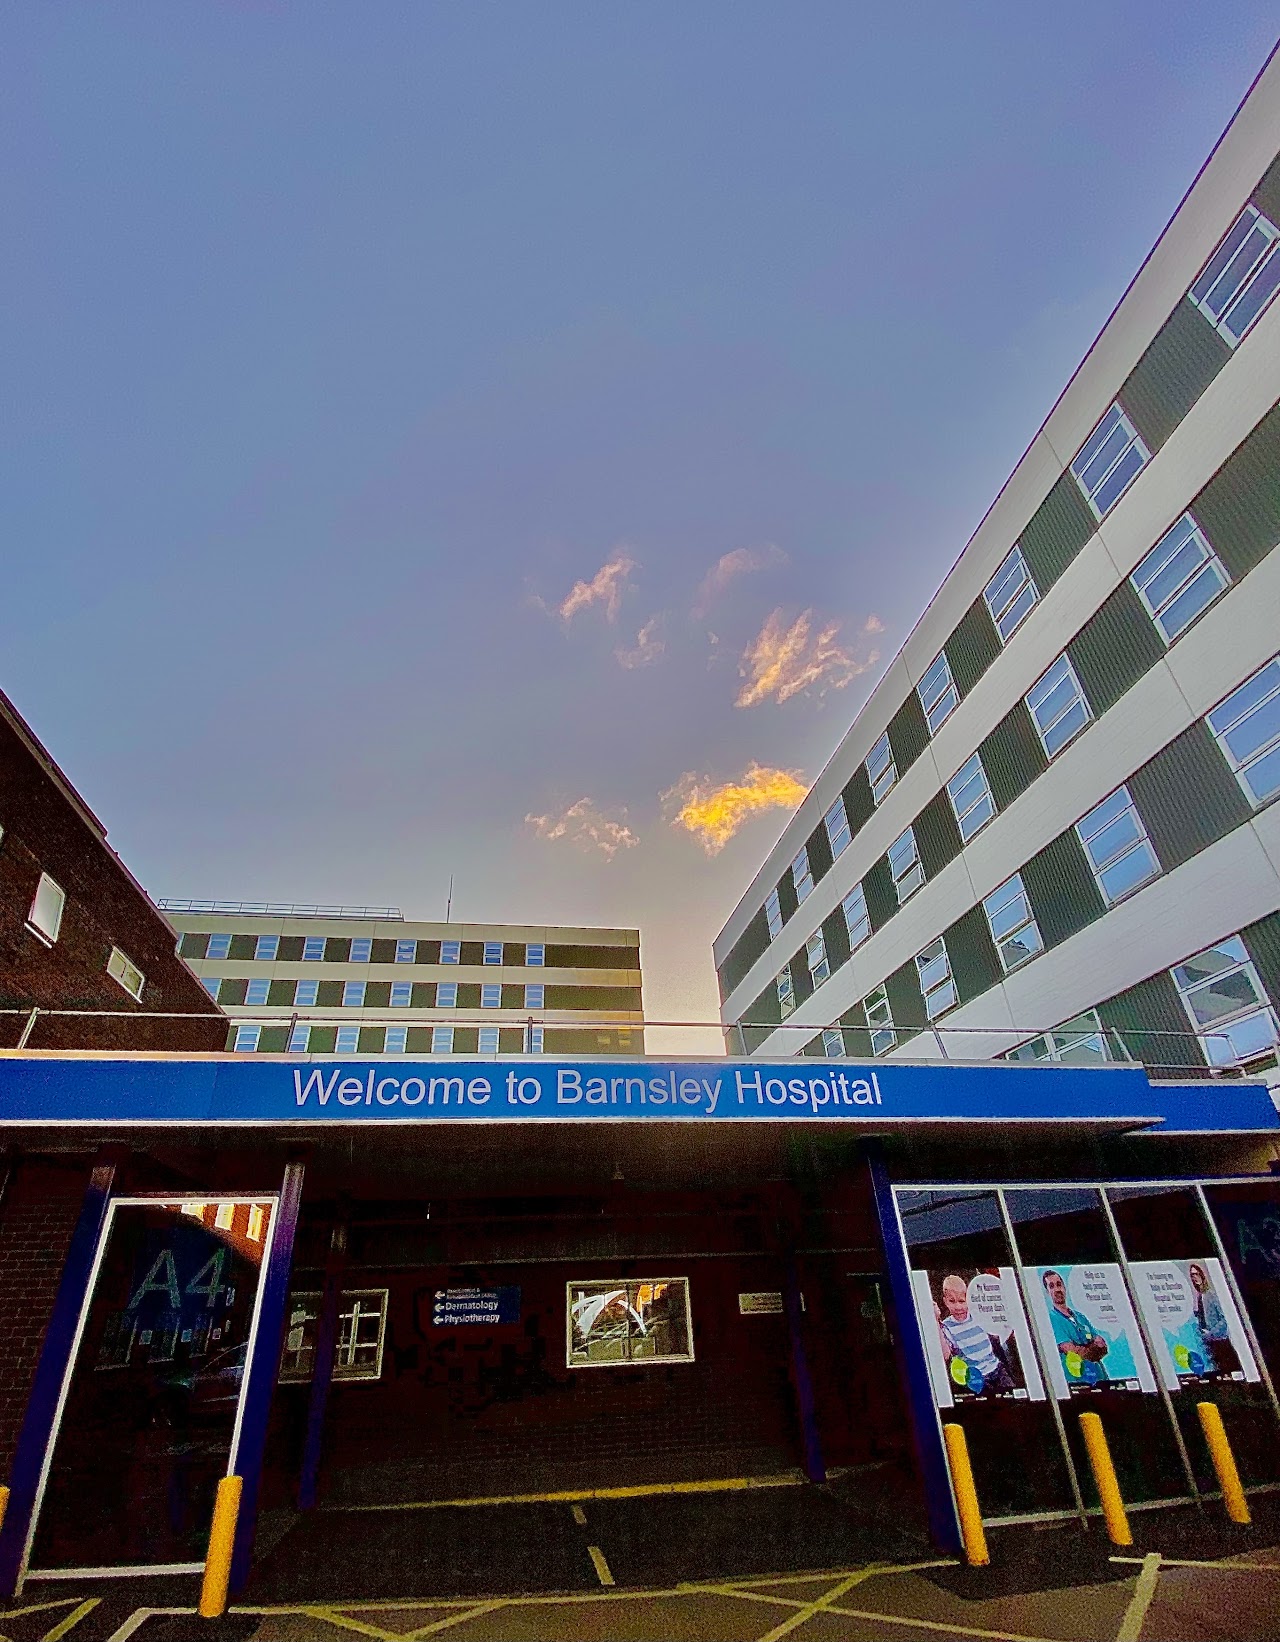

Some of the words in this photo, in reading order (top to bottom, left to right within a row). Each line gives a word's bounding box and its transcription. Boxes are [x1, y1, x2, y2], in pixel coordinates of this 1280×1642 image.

[292, 1068, 492, 1106] Welcome
[505, 1070, 542, 1104] to
[557, 1068, 722, 1114] Barnsley
[734, 1070, 883, 1113] Hospital
[127, 1249, 225, 1308] A4
[444, 1313, 501, 1325] Physiotherapy
[446, 1300, 499, 1311] Dermatology
